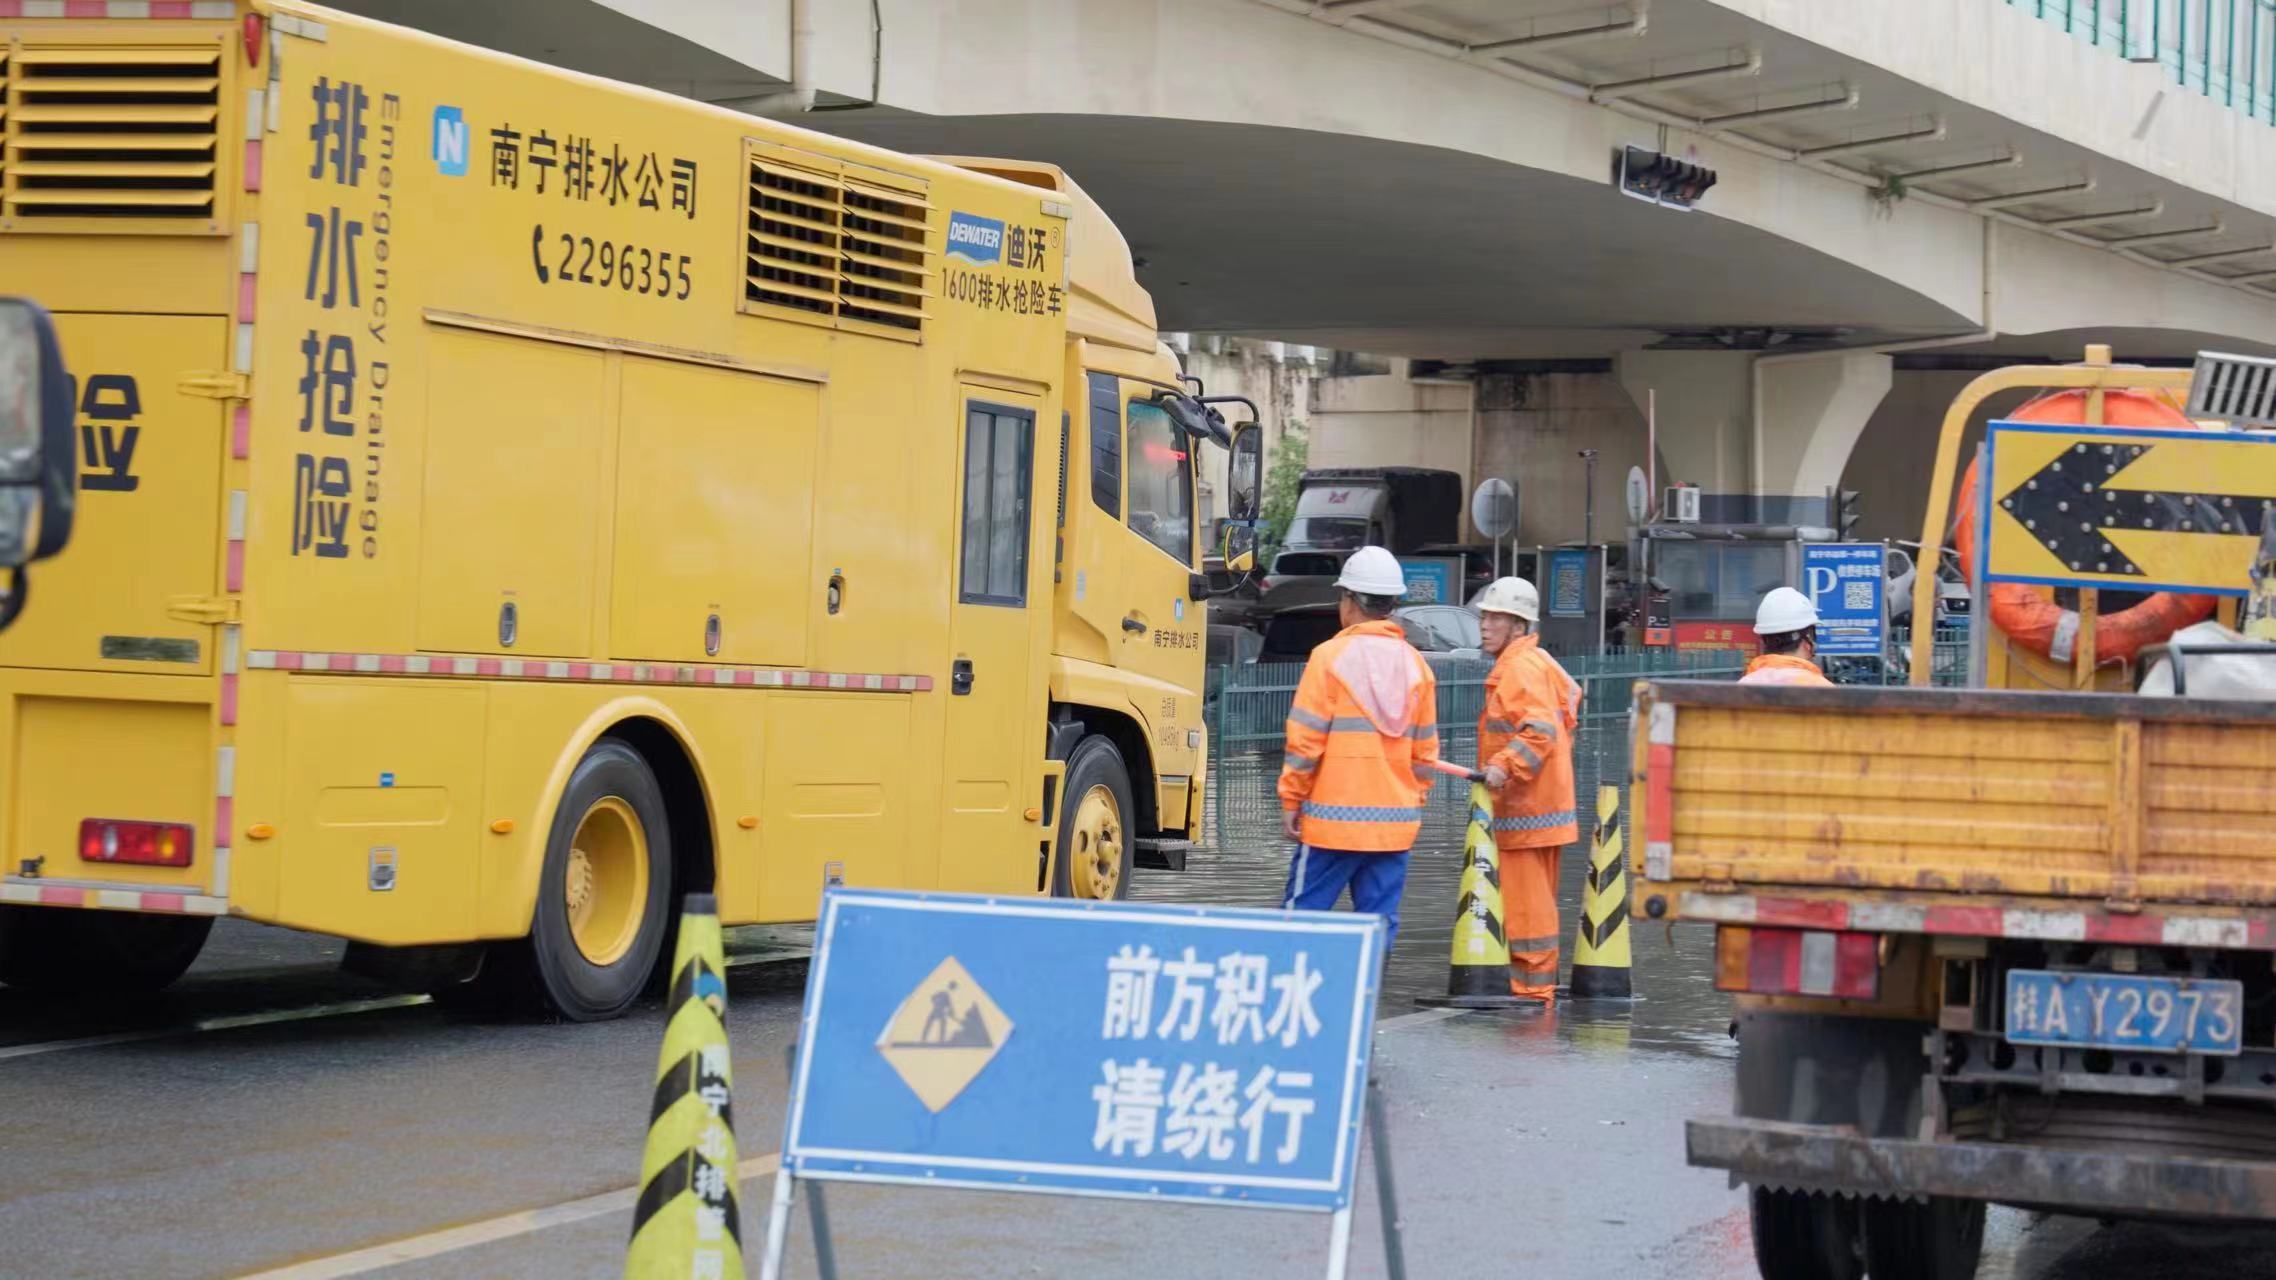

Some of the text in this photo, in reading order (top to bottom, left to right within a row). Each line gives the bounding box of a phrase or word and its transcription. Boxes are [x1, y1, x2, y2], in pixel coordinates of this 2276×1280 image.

[490, 122, 697, 220] 南宁排水公司
[558, 233, 692, 300] 2296355
[950, 221, 1001, 249] DEWATER
[291, 76, 369, 560] 排水抢险
[362, 92, 400, 560] Emergency Drainage
[942, 267, 1062, 317] 1600排水抢险车
[1806, 567, 1838, 612] P
[1154, 629, 1199, 650] 南宁排水公司
[1102, 944, 1324, 1048] 前方积水
[1092, 1058, 1316, 1165] 请绕行
